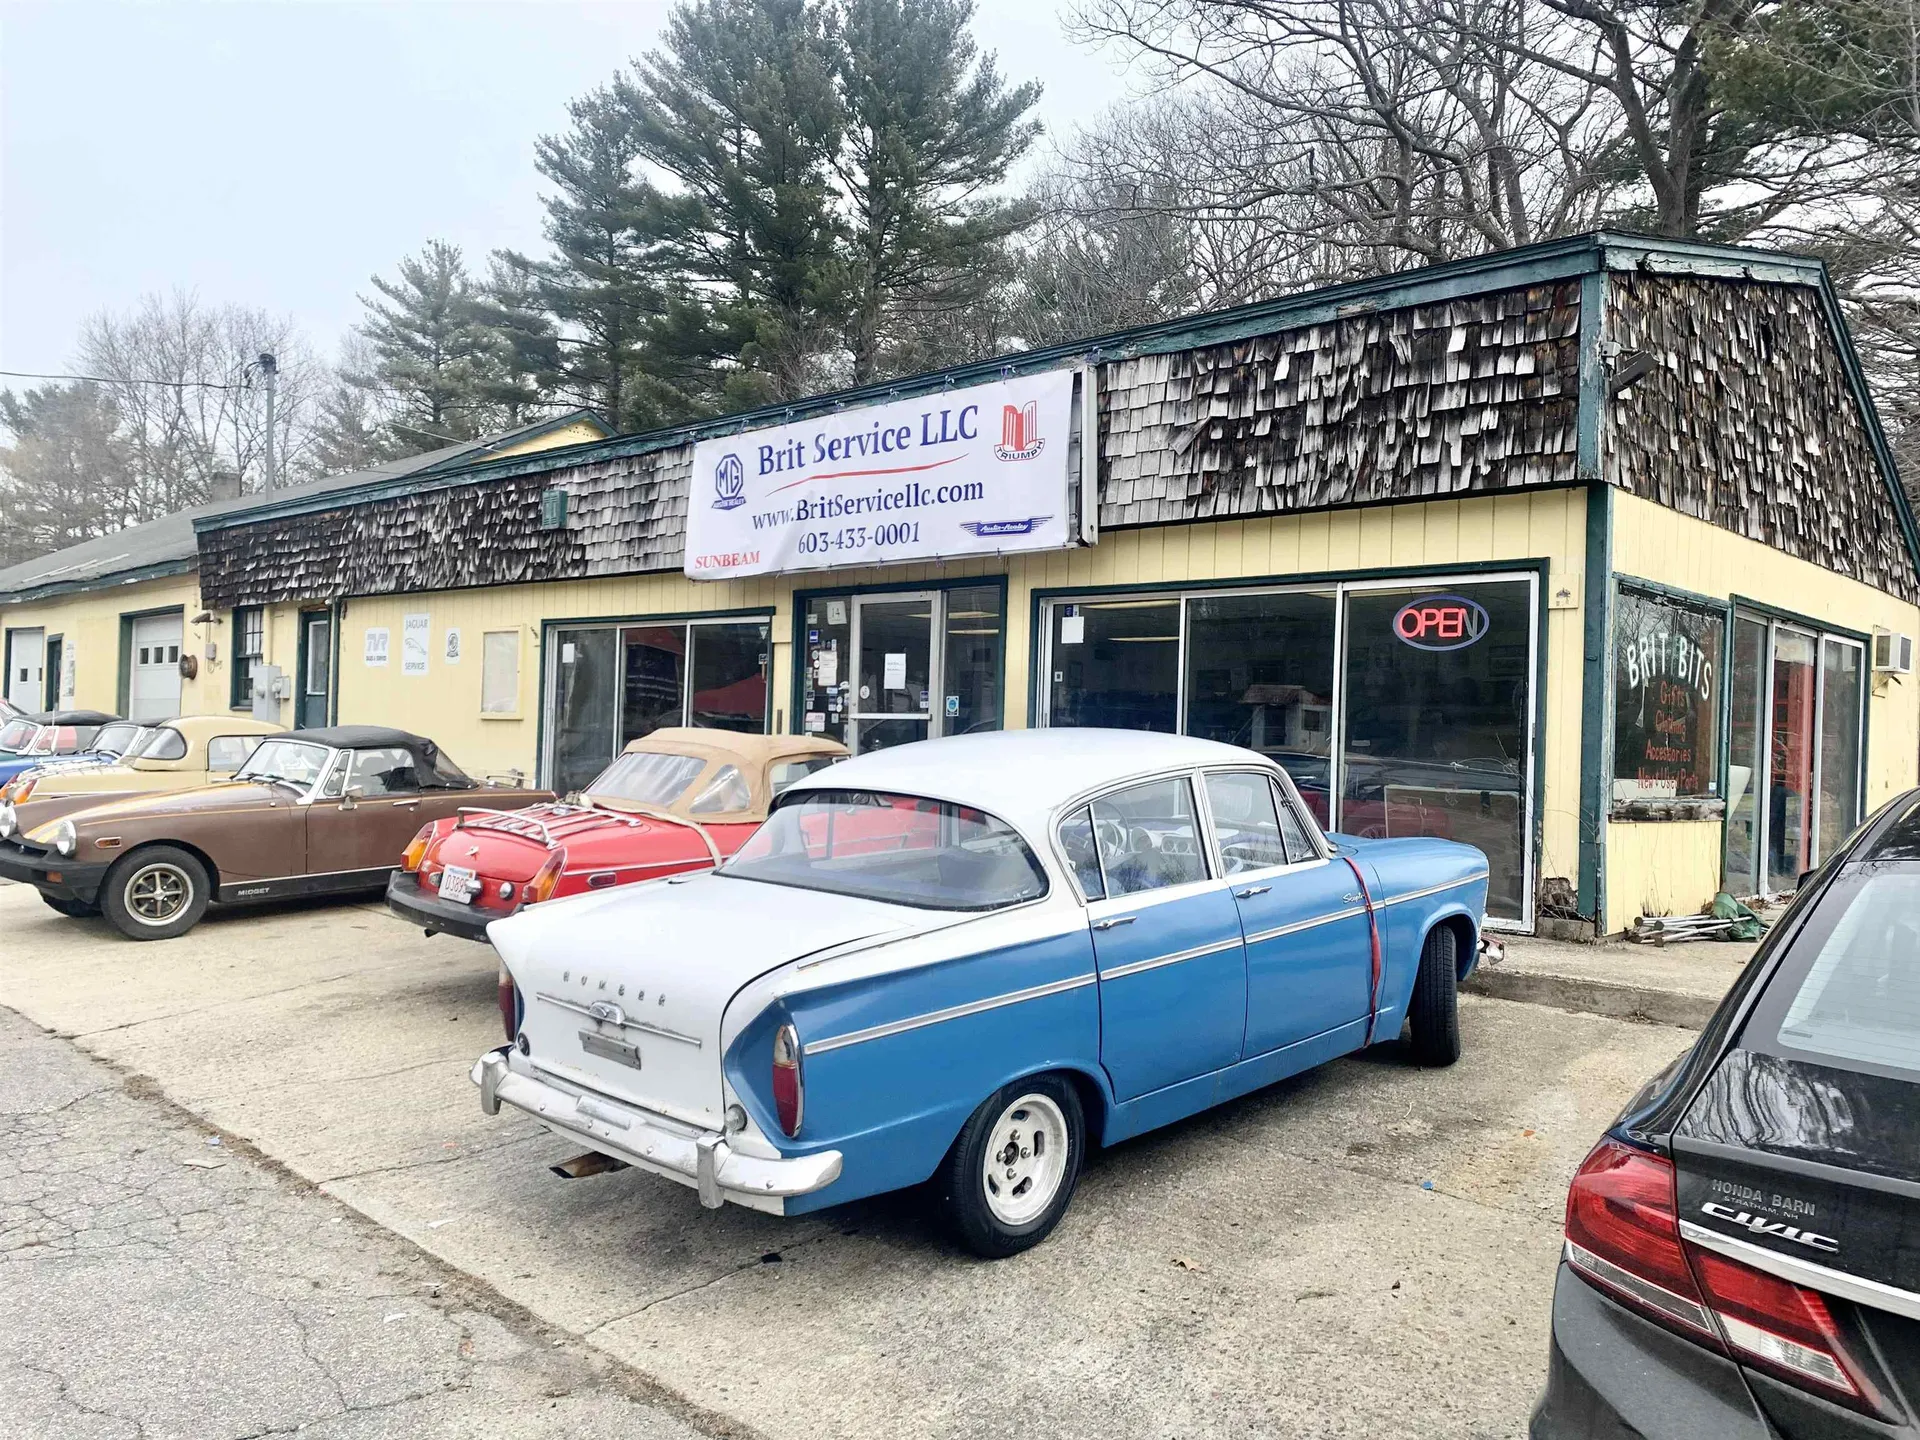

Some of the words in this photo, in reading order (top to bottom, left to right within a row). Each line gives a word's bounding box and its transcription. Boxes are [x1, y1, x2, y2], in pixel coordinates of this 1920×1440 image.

[758, 438, 806, 476] Brit
[812, 420, 910, 464] Service
[919, 404, 978, 447] LLC
[996, 440, 1043, 460] TRIUMPH
[718, 458, 741, 495] MG
[752, 480, 984, 530] www.BritServicellc.com
[798, 520, 920, 554] 603-433-0001
[694, 551, 760, 569] SUNBEAM
[405, 618, 428, 631] JAGUAR
[1399, 607, 1479, 639] OPEN
[405, 661, 425, 671] SERVICE
[1627, 633, 1669, 690] BRIT
[1678, 636, 1712, 700] BITS
[1660, 681, 1686, 707] Gifts
[1655, 709, 1687, 742] Clothing
[1645, 739, 1692, 762] Accessories
[237, 887, 270, 896] MIDGET
[1712, 1179, 1762, 1203] HONDA
[1771, 1194, 1816, 1216] BARN
[1723, 1195, 1779, 1217] STRATHAM,
[1783, 1210, 1799, 1220] NH
[1701, 1201, 1839, 1254] CIVIC
